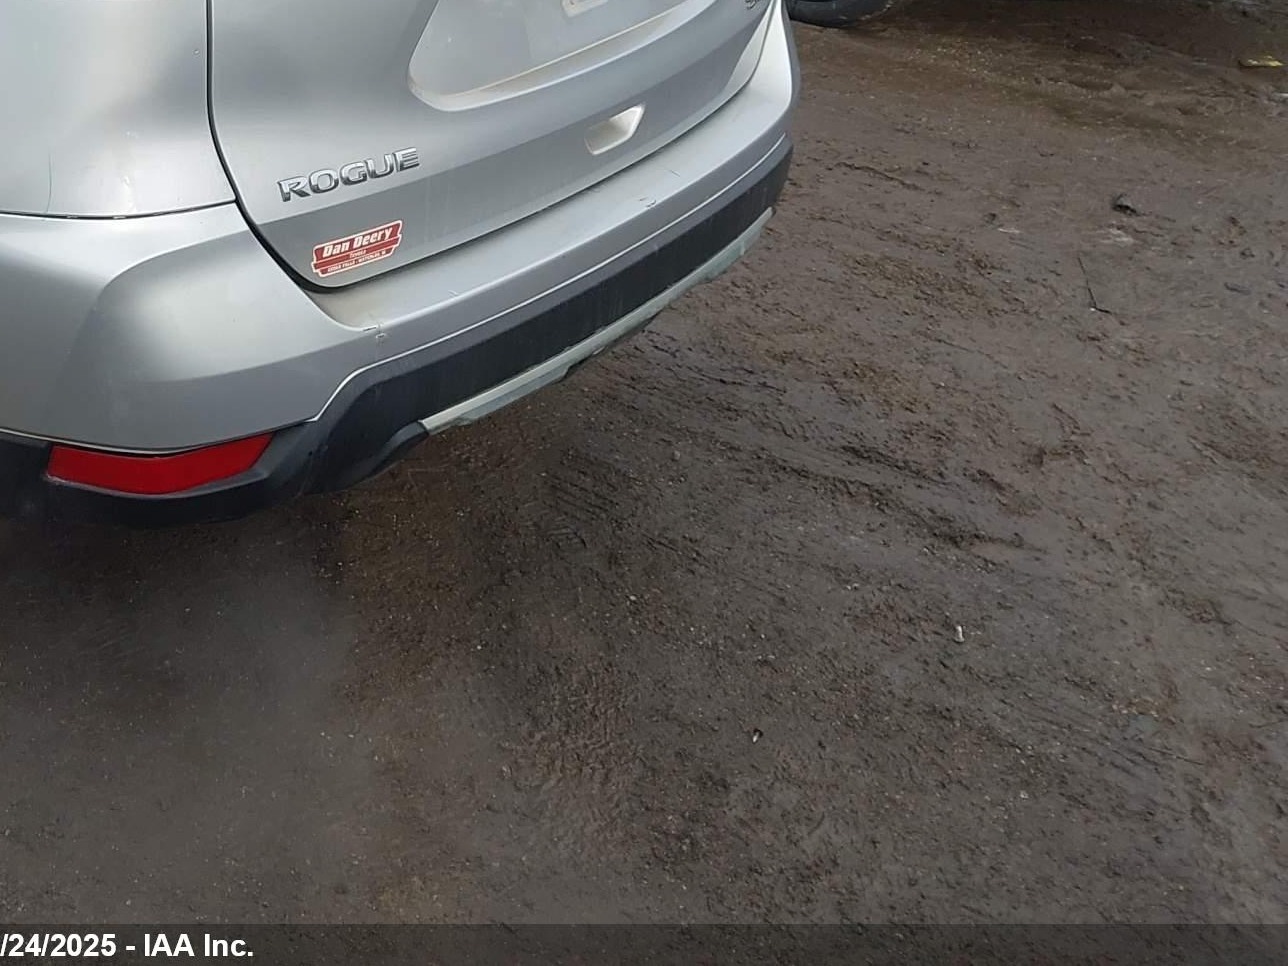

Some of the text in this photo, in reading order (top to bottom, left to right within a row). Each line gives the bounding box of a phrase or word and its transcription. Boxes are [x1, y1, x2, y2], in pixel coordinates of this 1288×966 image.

[277, 147, 420, 202] ROGUE
[322, 242, 350, 258] Dan
[352, 228, 392, 249] Deery
